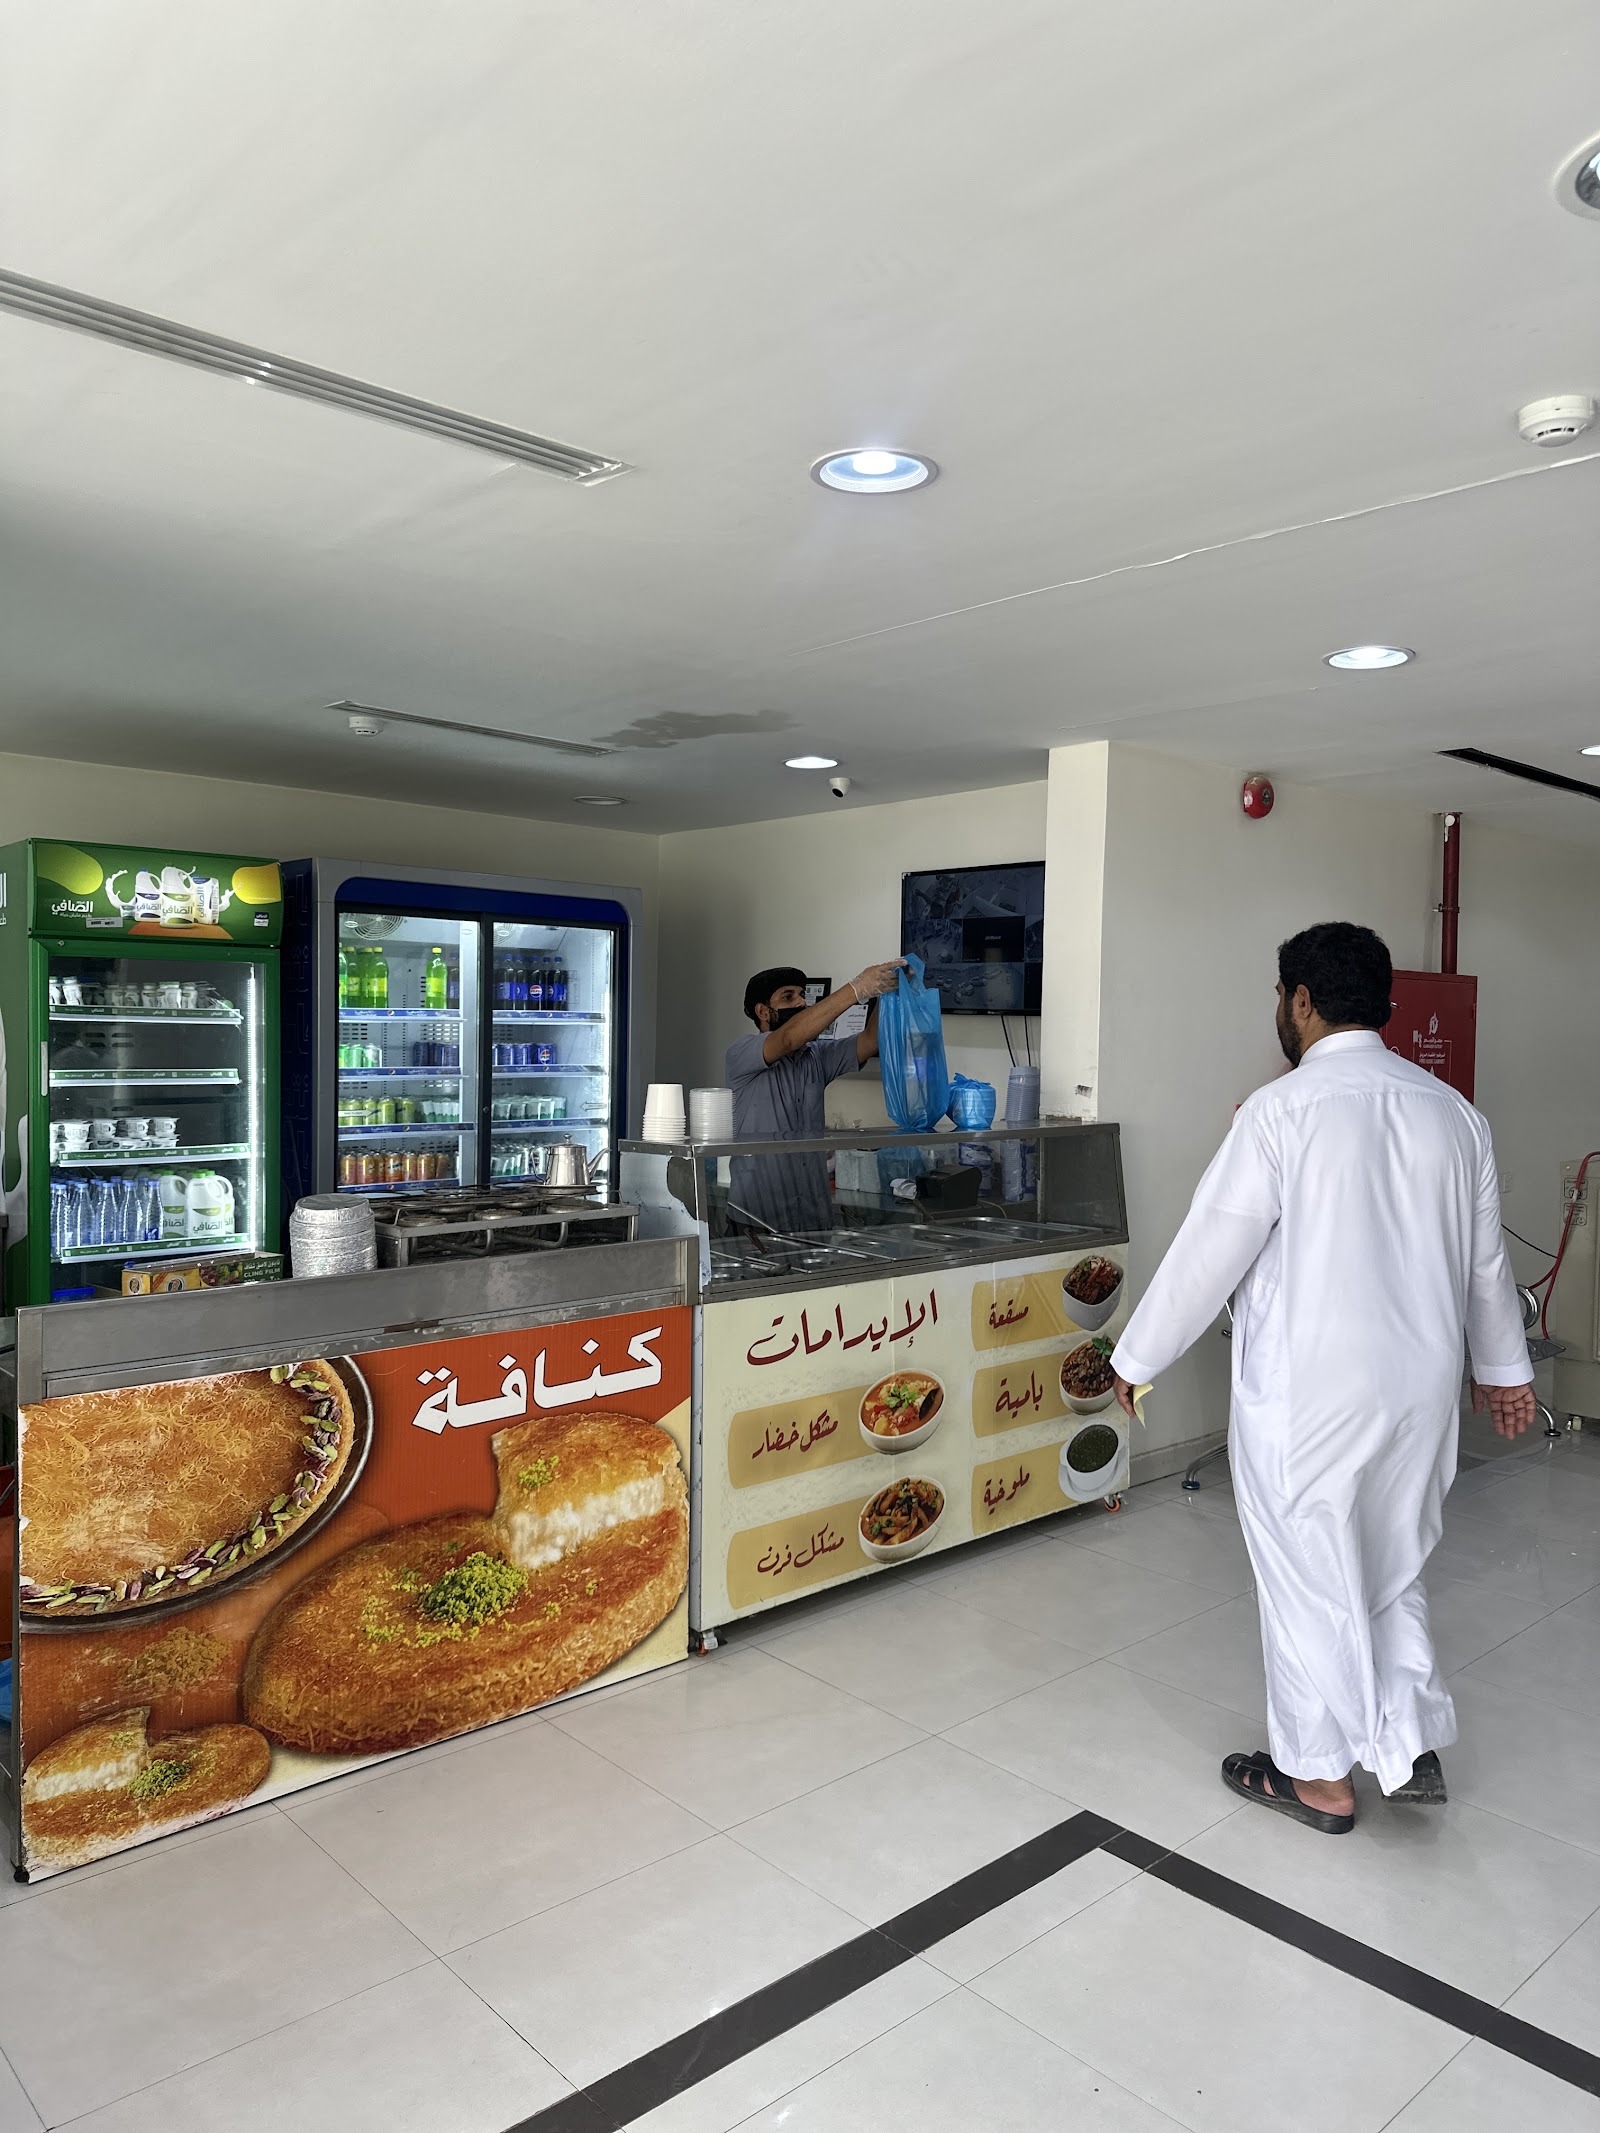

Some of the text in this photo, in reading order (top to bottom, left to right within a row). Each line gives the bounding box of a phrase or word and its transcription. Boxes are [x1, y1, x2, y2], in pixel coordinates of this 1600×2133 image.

[51, 899, 94, 916] الصافي
[243, 1269, 264, 1278] CLING
[746, 1288, 938, 1366] الإيدامات
[989, 1299, 1029, 1329] مسقعة
[412, 1326, 663, 1435] كنافة
[995, 1370, 1043, 1419] بامية
[752, 1409, 839, 1459] مشكل خضار
[984, 1465, 1030, 1515] ملوخية
[757, 1522, 845, 1576] مشكل فرن
